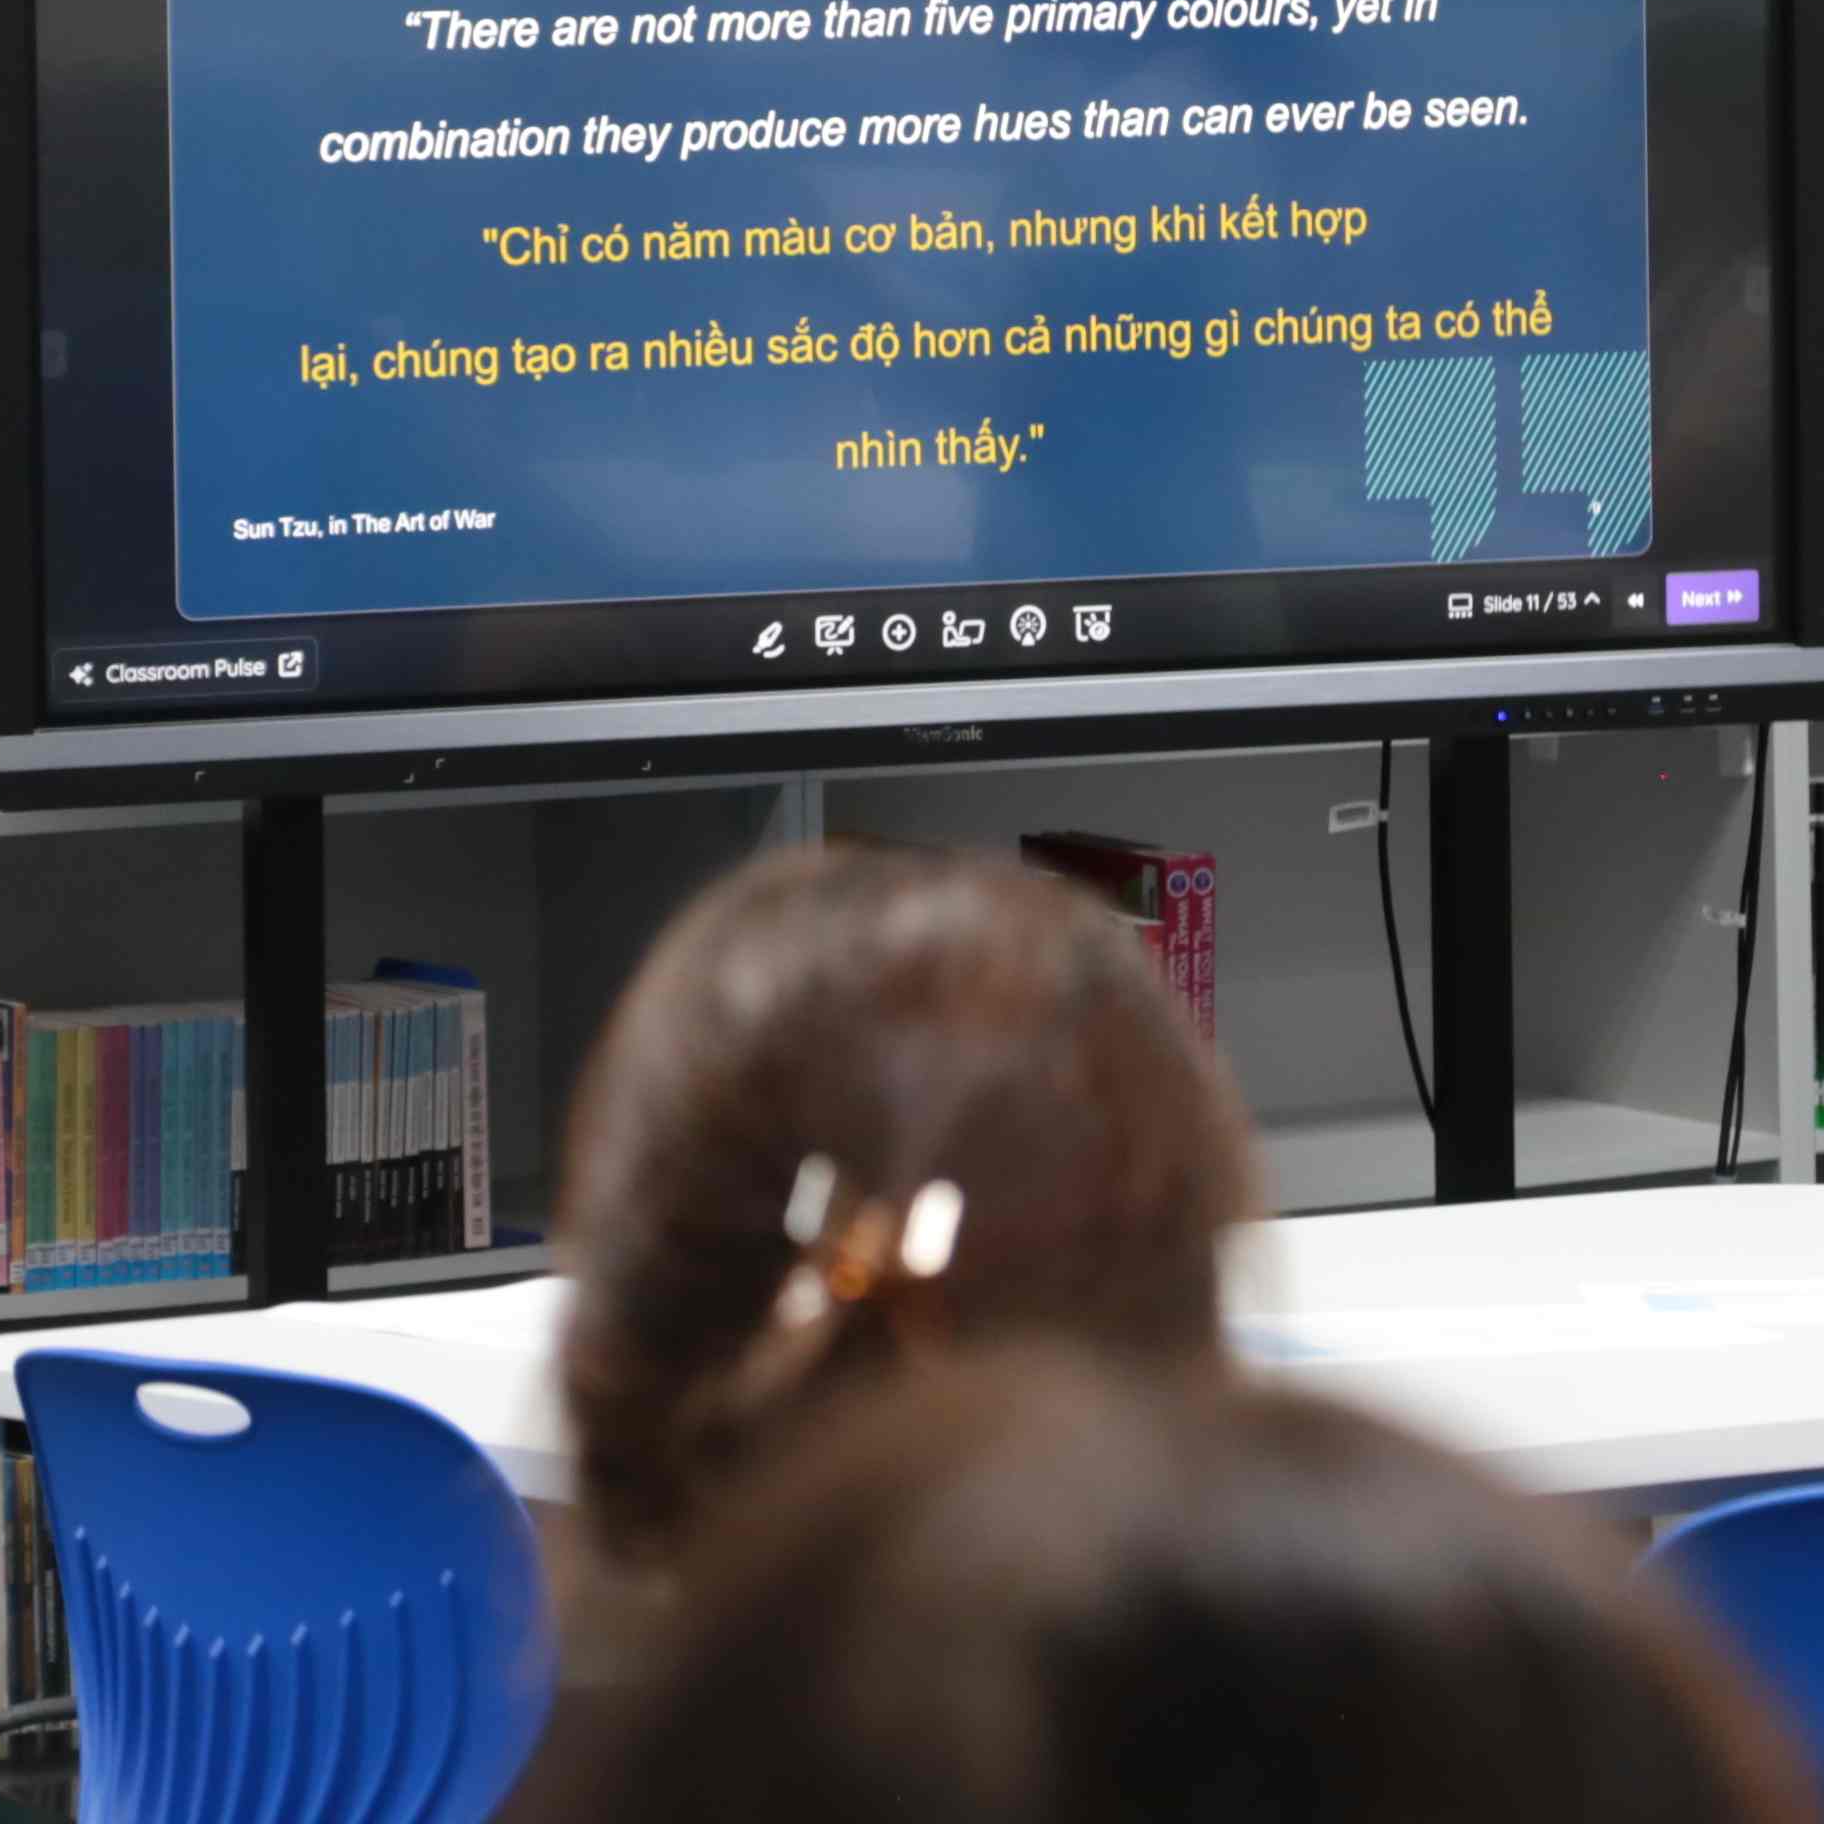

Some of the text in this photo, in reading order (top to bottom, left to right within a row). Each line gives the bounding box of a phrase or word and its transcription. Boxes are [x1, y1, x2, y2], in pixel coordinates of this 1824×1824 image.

[551, 15, 619, 47] are
[630, 5, 698, 44] not
[706, 9, 812, 42] more
[824, 0, 912, 39] than
[319, 91, 1528, 163] combination they produce more hues than can ever be seen.
[581, 224, 629, 262] có
[644, 223, 730, 259] năm
[745, 219, 831, 256] màu
[845, 223, 897, 253] cơ
[910, 212, 996, 256] bản,
[1010, 212, 1137, 254] nhưng
[1151, 207, 1205, 241] khi
[1220, 196, 1278, 240] kết
[1291, 203, 1368, 244] hợp
[301, 289, 1553, 388] lại, chúng tạo ra nhiều sắc độ hơn cả những gì chúng ta có thể
[836, 431, 922, 467] nhìn
[233, 509, 496, 540] Sun Tzu, in The Art of War
[1483, 591, 1523, 616] Slide
[1527, 591, 1541, 614] 11
[1556, 589, 1578, 612] 53
[1681, 587, 1722, 610] Next
[105, 655, 266, 684] Classroom Pulse
